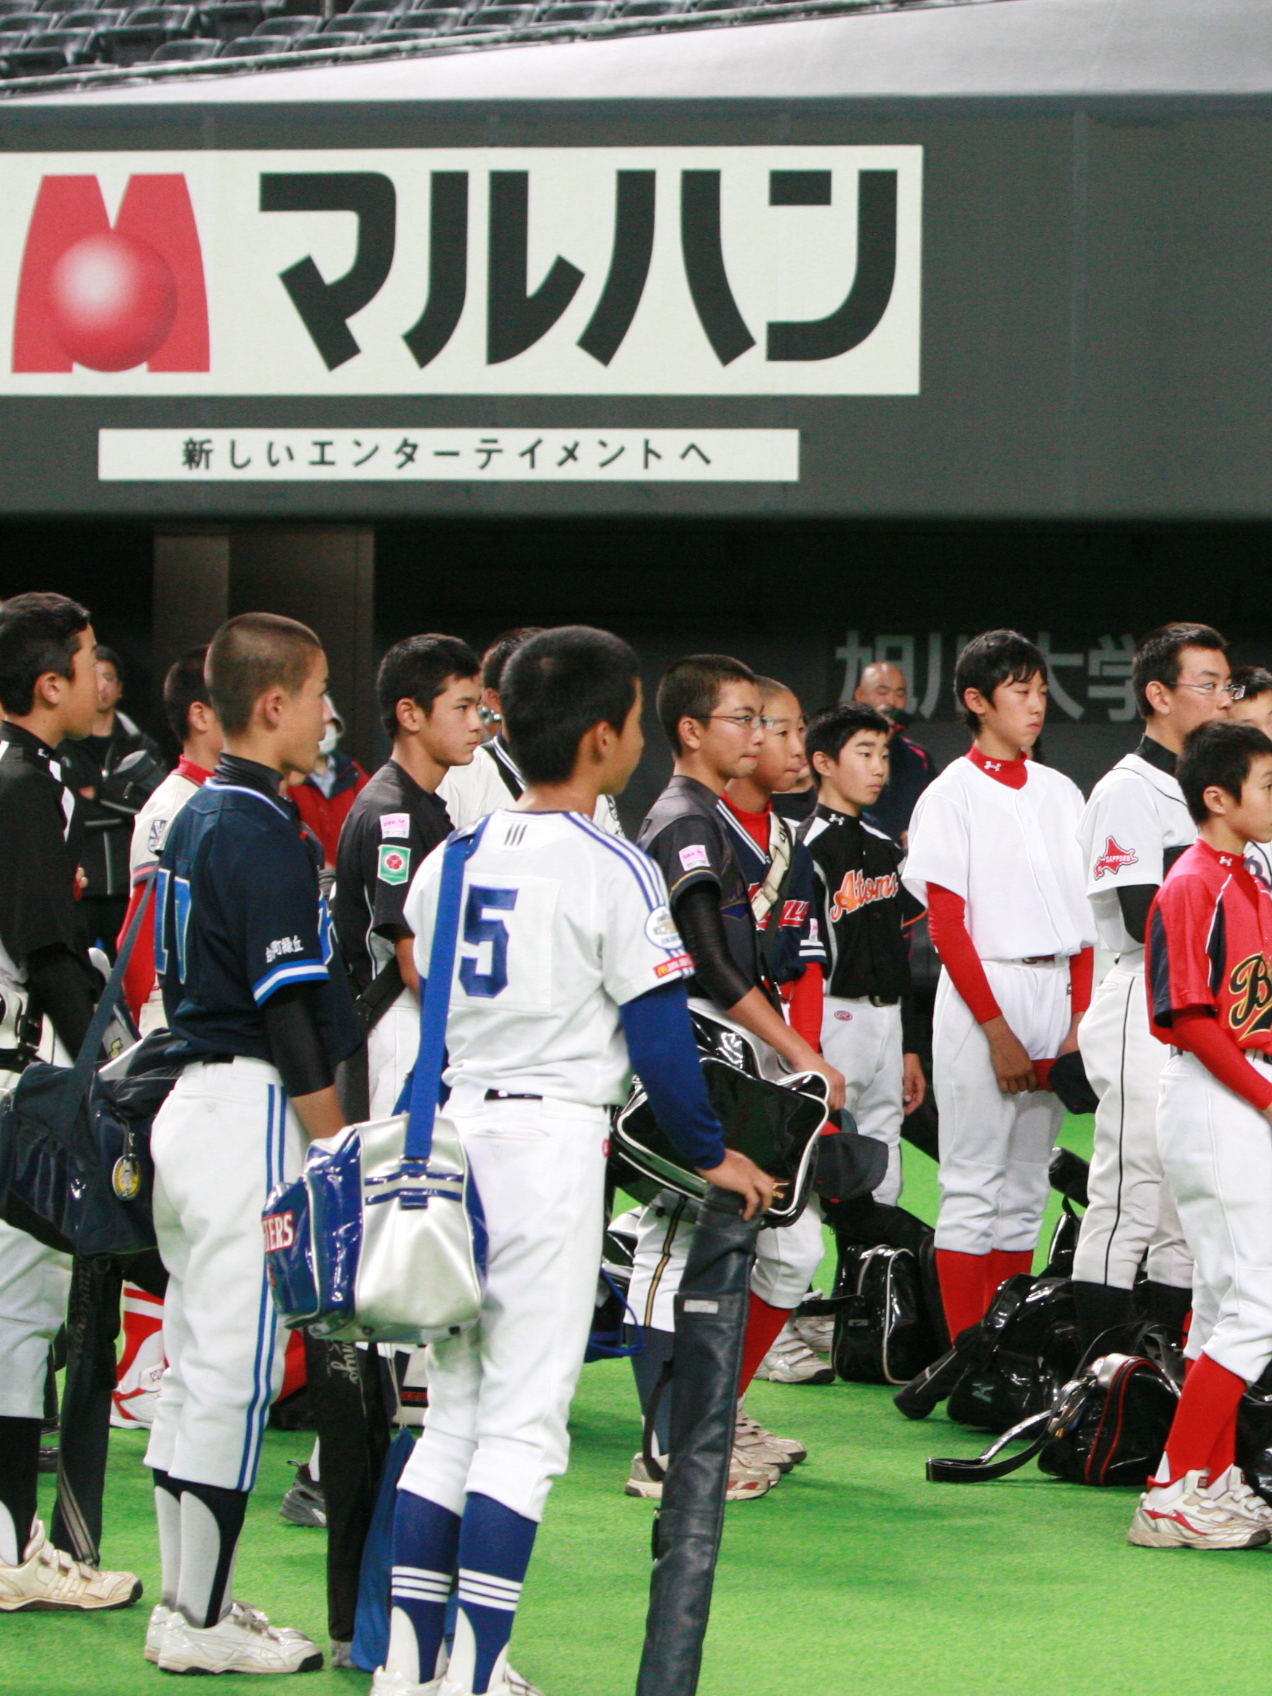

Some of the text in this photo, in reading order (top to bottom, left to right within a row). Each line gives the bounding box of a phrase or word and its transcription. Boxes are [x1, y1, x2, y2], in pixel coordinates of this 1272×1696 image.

[260, 169, 898, 372] マルハン
[183, 438, 712, 470] 新しいエンターテイメントへ
[459, 884, 520, 999] 5
